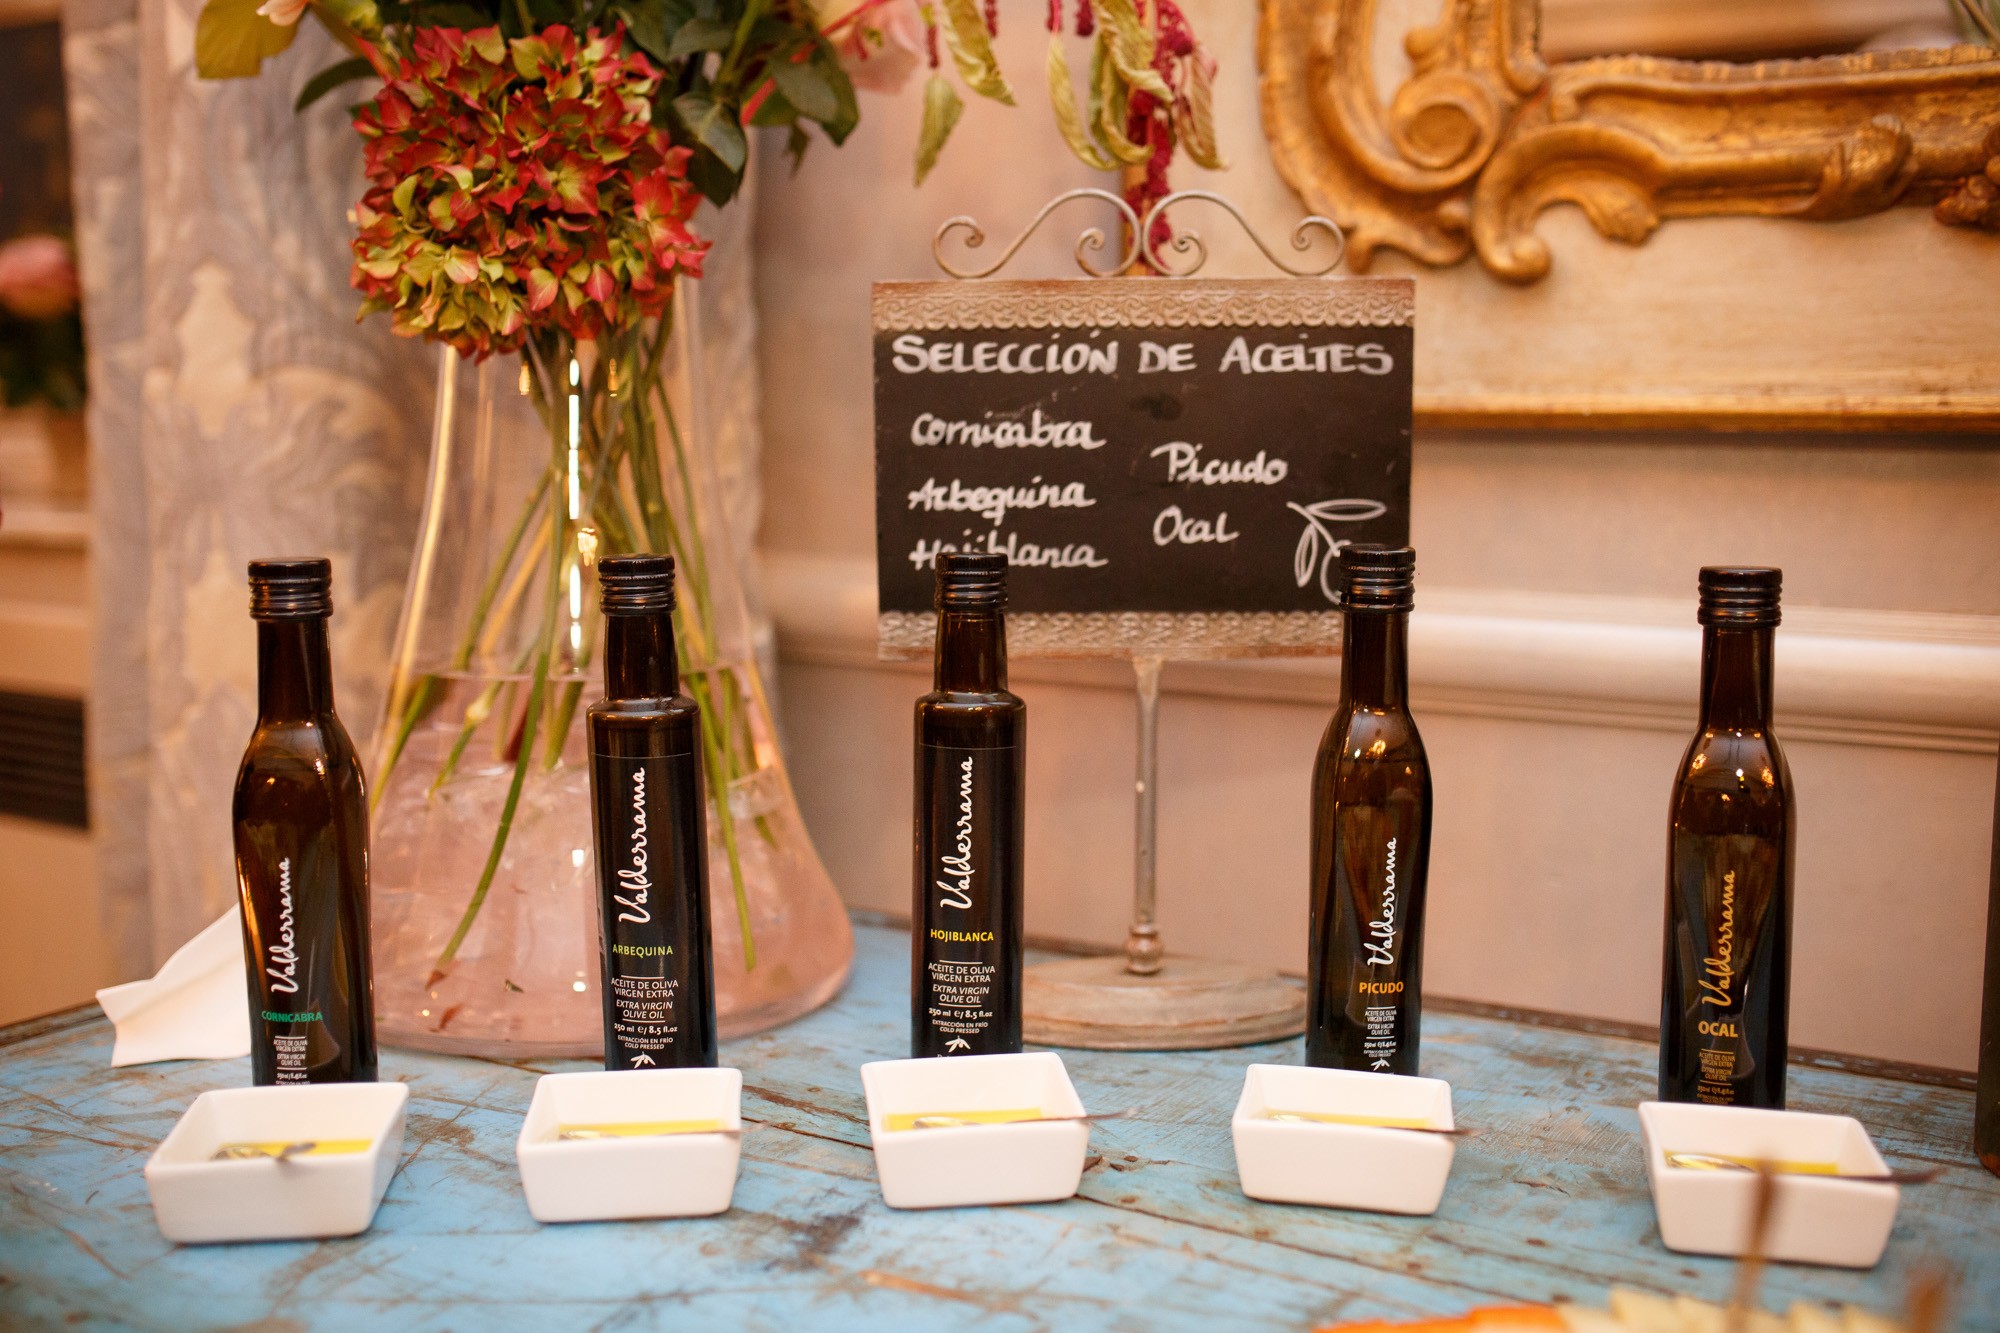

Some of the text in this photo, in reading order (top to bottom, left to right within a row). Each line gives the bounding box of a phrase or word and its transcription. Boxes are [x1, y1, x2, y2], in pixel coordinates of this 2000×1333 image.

[1138, 341, 1198, 374] DE
[1218, 333, 1394, 375] ACEITES
[910, 409, 1106, 449] Cornicabra
[1150, 441, 1288, 485] Picudo
[908, 475, 1097, 526] Arbequina
[1153, 504, 1240, 546] Ocal
[936, 756, 976, 909] Valderrama
[613, 767, 653, 924] Valderrama
[1363, 837, 1397, 966] Valderrama
[266, 857, 299, 993] Valderrama
[930, 929, 994, 942] HOJIBLANCA
[1698, 870, 1735, 1006] Valderrama
[612, 944, 673, 958] ARBEQUINA
[928, 963, 995, 974] ACEITE DE OLIVA
[611, 978, 679, 989] ACEITE DE OLIVA
[931, 972, 991, 983] VIRGEN EXTRA
[614, 987, 674, 998] VIRGEN EXTRA
[932, 984, 990, 994] EXTRA VIRGIN
[1359, 981, 1404, 994] PICUDO
[616, 999, 673, 1010] EXTRA VIRGIN
[940, 994, 981, 1003] OLIVE OIL
[261, 1011, 323, 1022] CORNICABRA
[623, 1010, 664, 1019] OLIVE OIL
[928, 1007, 941, 1016] 250
[965, 1010, 977, 1019] 8.5
[614, 1023, 625, 1031] 250
[648, 1026, 661, 1035] 8.5
[1698, 1020, 1739, 1038] OCAL
